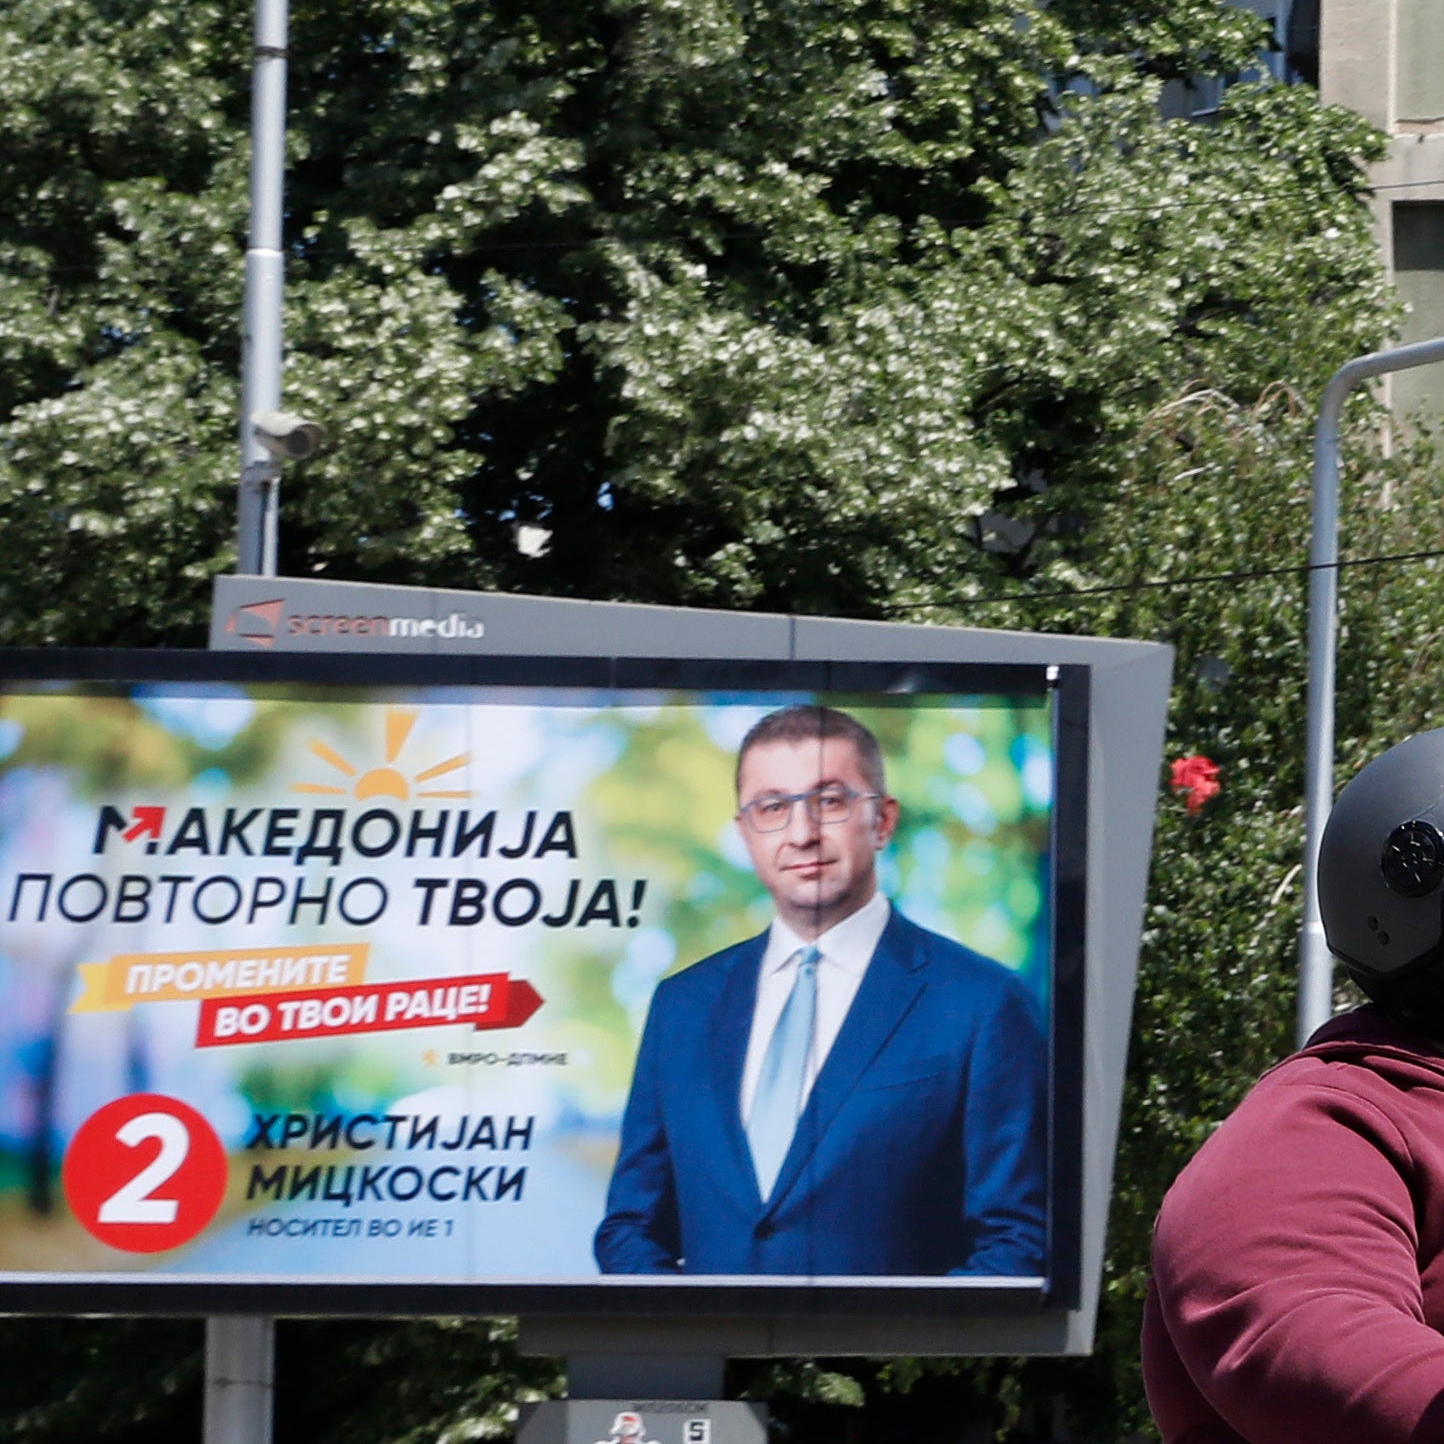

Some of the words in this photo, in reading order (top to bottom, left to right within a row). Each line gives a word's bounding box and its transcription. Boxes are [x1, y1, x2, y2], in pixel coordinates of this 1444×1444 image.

[7, 873, 389, 926] ПОВТОРНО
[414, 878, 648, 928] ТВОЈА!
[125, 954, 351, 994] ПРОМЕНИТЕ
[213, 1004, 270, 1037] ВО
[279, 994, 376, 1031] ТВОИ
[383, 984, 492, 1022] РАЦЕ!
[246, 1114, 535, 1151] ХРИСТИЈАН
[98, 1112, 190, 1224] 2
[246, 1164, 528, 1207] МИЦКОСКИ
[248, 1218, 361, 1238] НОСИТЕЛ
[367, 1219, 400, 1238] ВО
